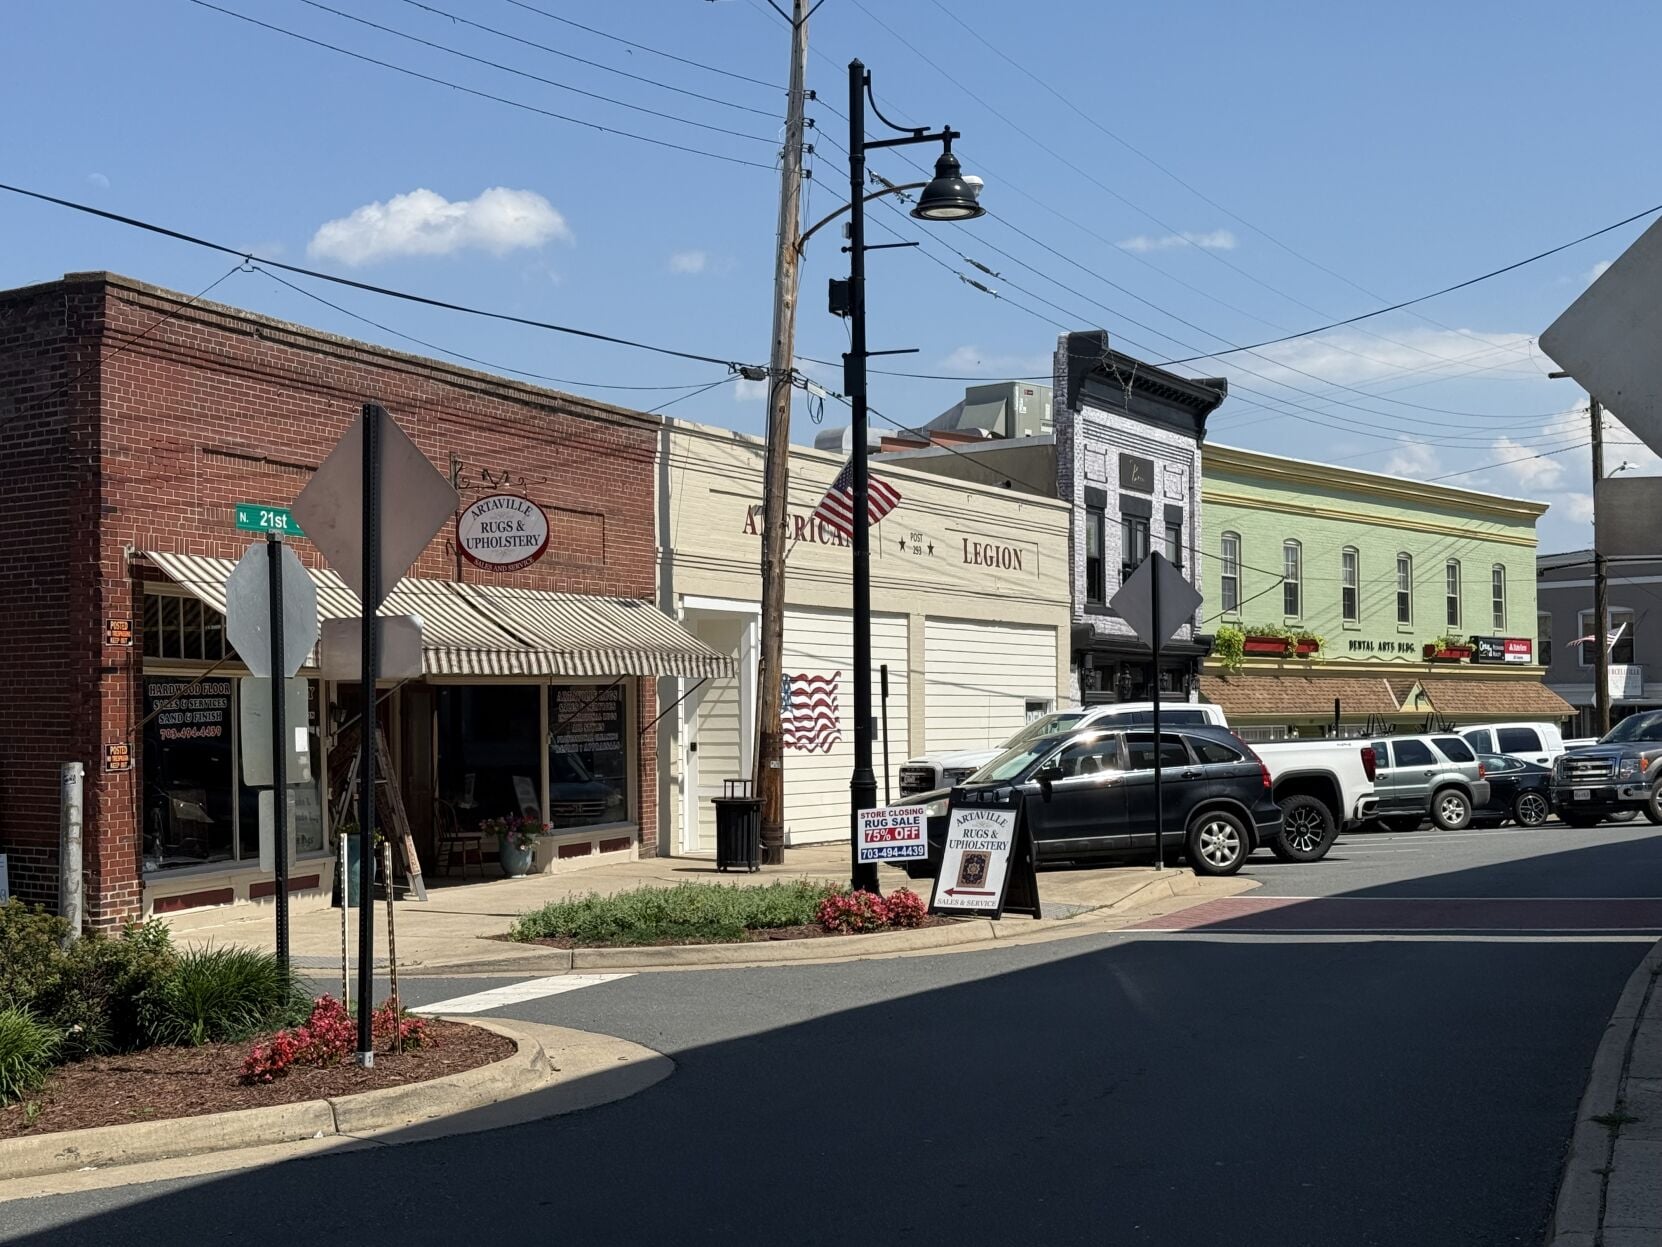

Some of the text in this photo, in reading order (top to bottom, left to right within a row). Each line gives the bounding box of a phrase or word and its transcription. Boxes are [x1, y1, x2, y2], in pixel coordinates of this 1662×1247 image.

[471, 499, 533, 520] ARTAVILLE
[240, 511, 287, 528] N. 21st
[481, 520, 525, 534] RUGS &
[466, 535, 540, 550] UPHOLSTERY
[910, 532, 923, 542] POST
[962, 538, 1023, 571] LEGION
[473, 559, 492, 570] SALES
[508, 558, 535, 571] SERVICE
[110, 620, 129, 630] POSTED
[1349, 640, 1374, 652] DENTAL
[1378, 641, 1395, 653] ARTS
[149, 682, 231, 696] HARDWOOD FLOOR
[188, 698, 228, 709] SERVICES
[158, 712, 183, 724] SAND
[193, 711, 223, 723] FINISH
[110, 745, 128, 755] POSTED
[860, 807, 924, 819] STORE CLOSING
[955, 811, 1009, 828] ARTAVILLE
[865, 816, 920, 828] RUG SALE
[865, 827, 919, 842] 75% OFF
[962, 829, 999, 839] RUGS &
[949, 840, 1009, 851] UPHOLSTERY
[862, 845, 924, 860] 703-494-4439
[966, 899, 997, 907] SERVICE
